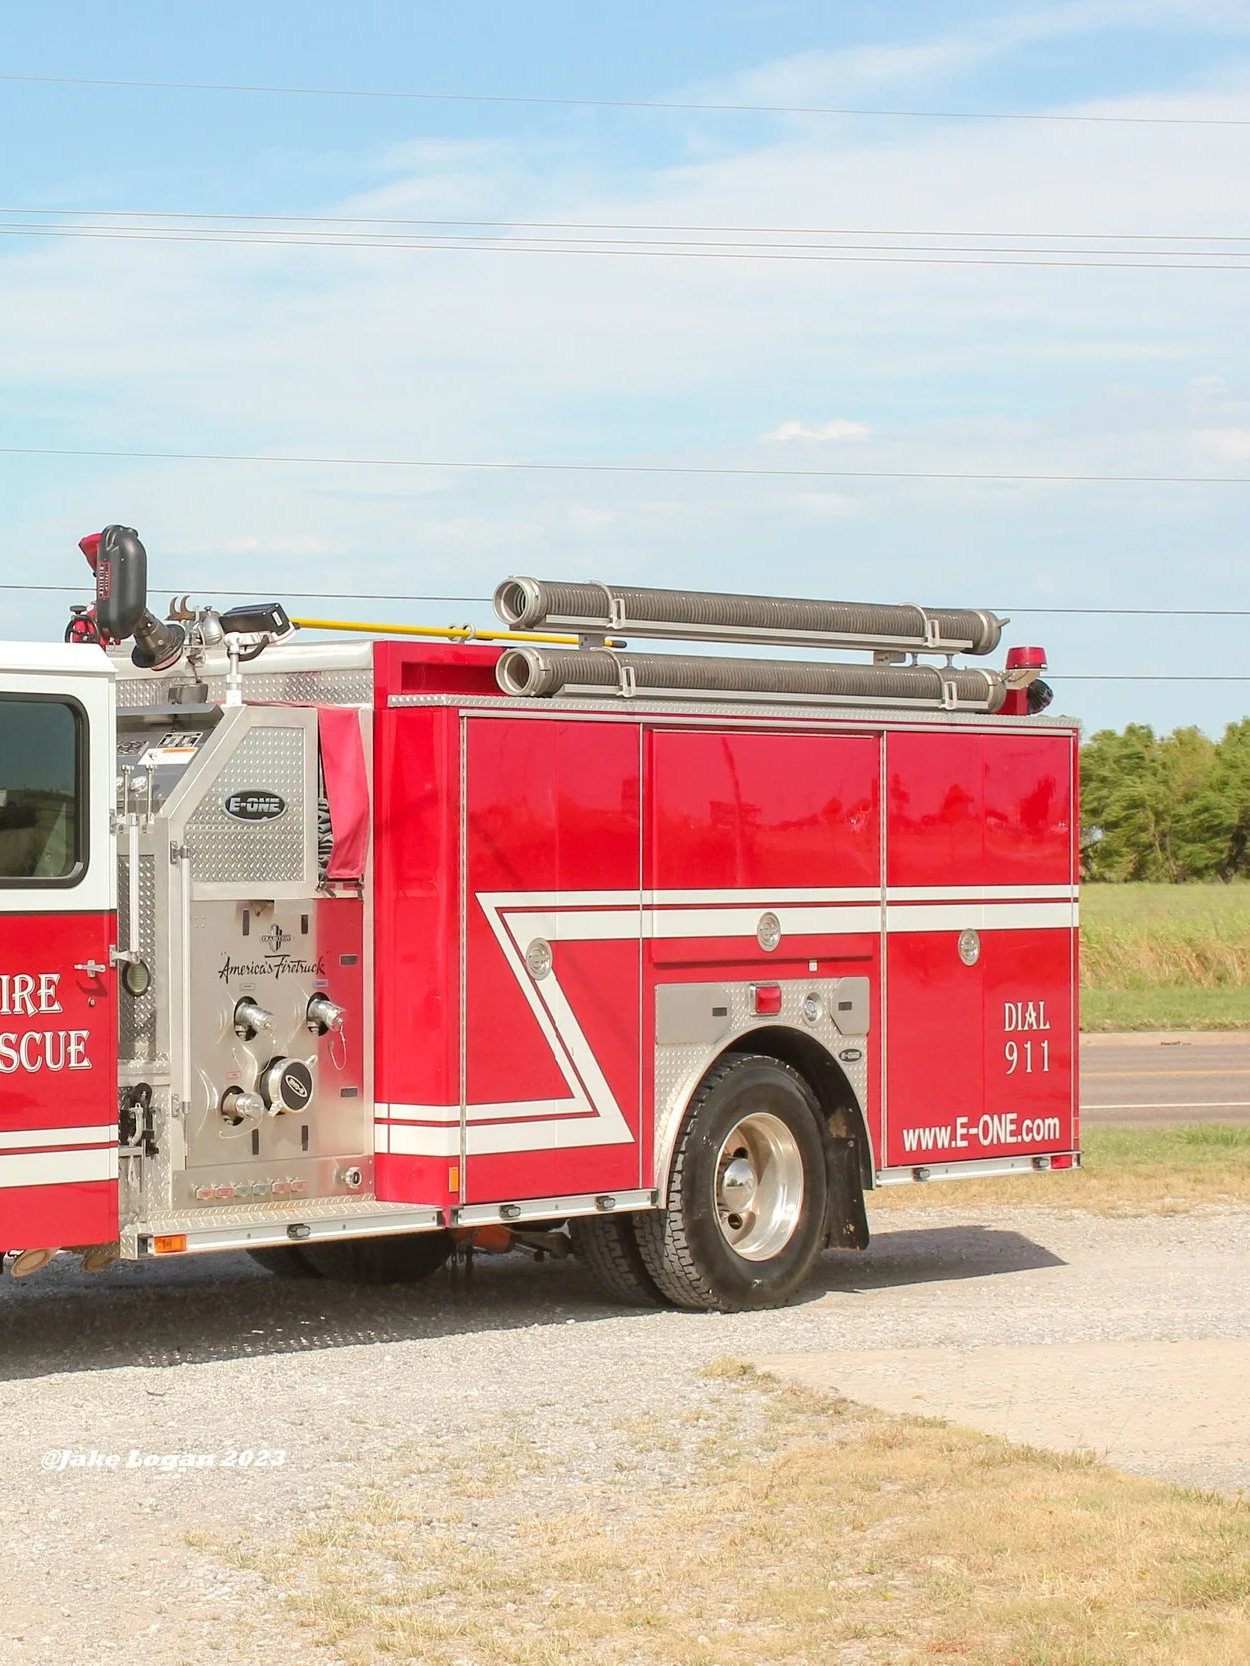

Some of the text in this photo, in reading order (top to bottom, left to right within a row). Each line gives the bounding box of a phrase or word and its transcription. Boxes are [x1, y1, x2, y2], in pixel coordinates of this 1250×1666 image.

[229, 797, 281, 813] E-ONE
[1004, 1001, 1050, 1031] DIAL
[1005, 1039, 1050, 1075] 911
[903, 1113, 1060, 1152] www.E-ONE.com
